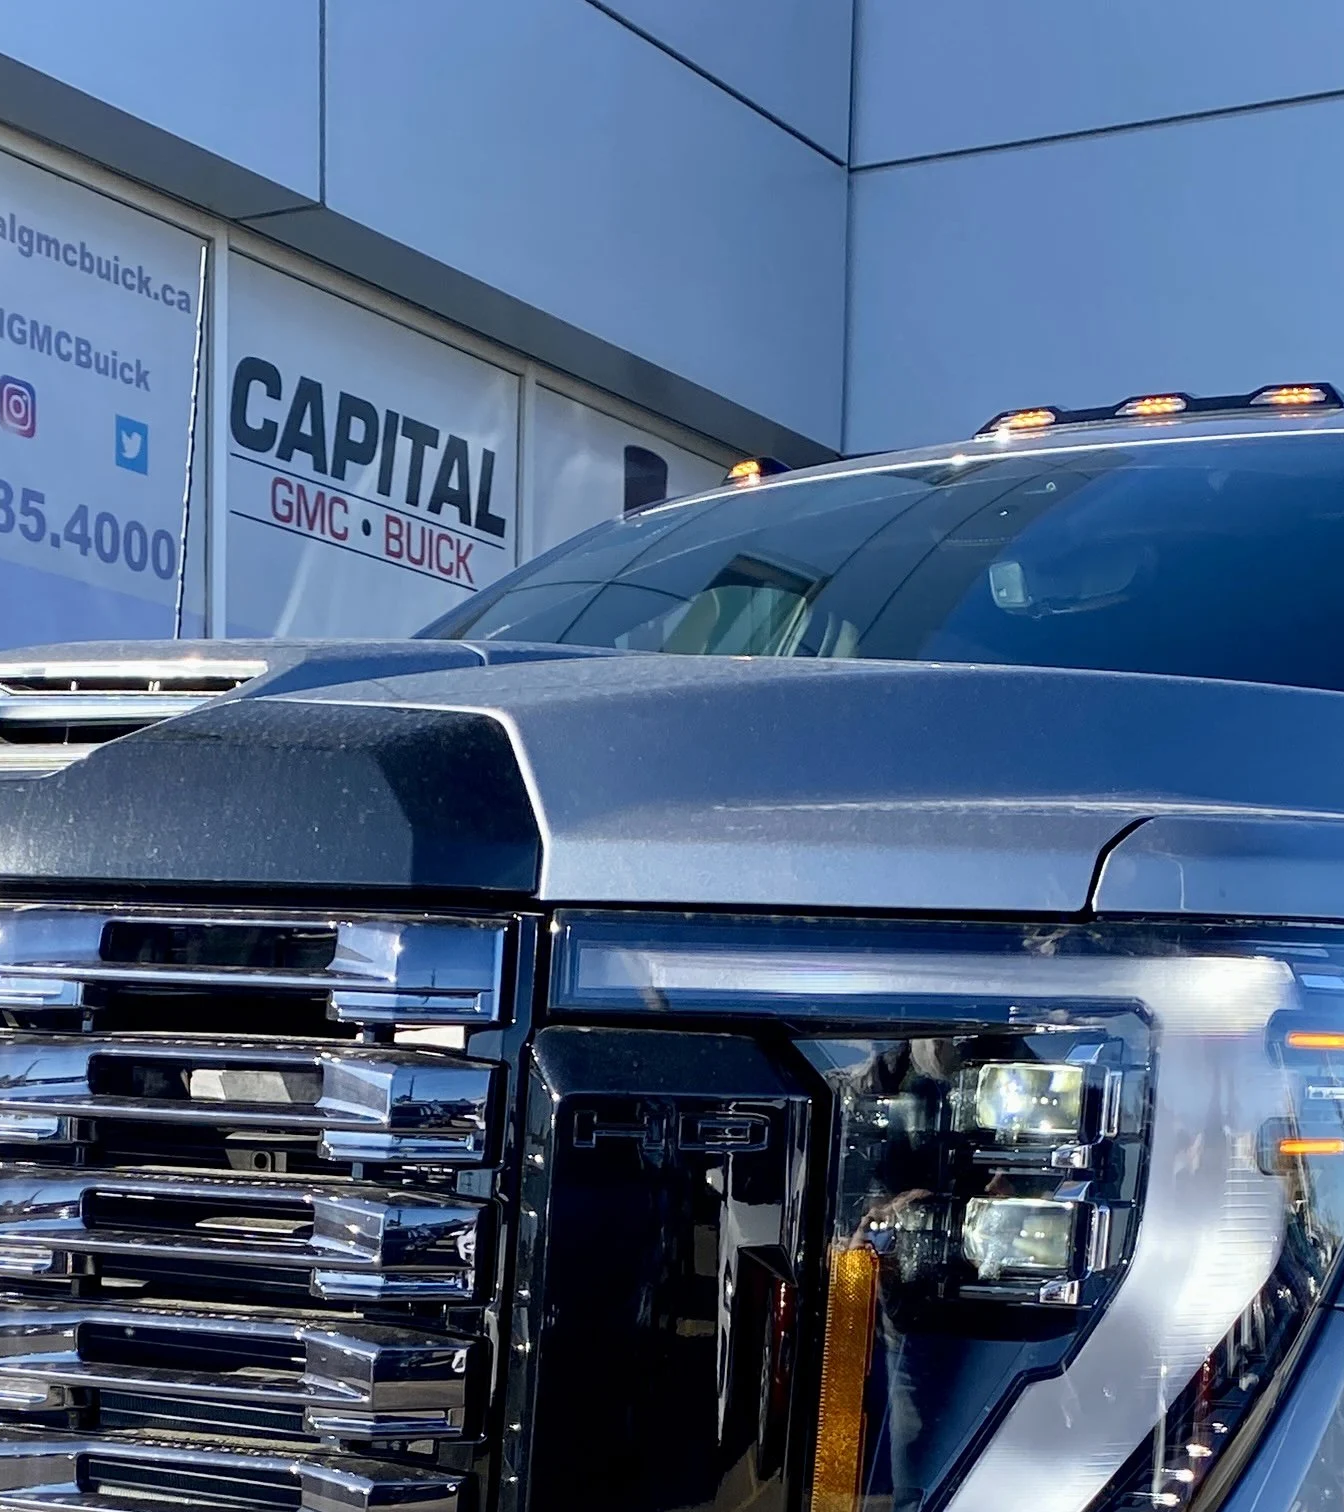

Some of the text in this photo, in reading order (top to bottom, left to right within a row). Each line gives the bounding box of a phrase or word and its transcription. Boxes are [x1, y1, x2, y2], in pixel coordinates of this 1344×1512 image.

[229, 355, 506, 539] CAPITAL
[270, 475, 474, 575] GMC BUICK
